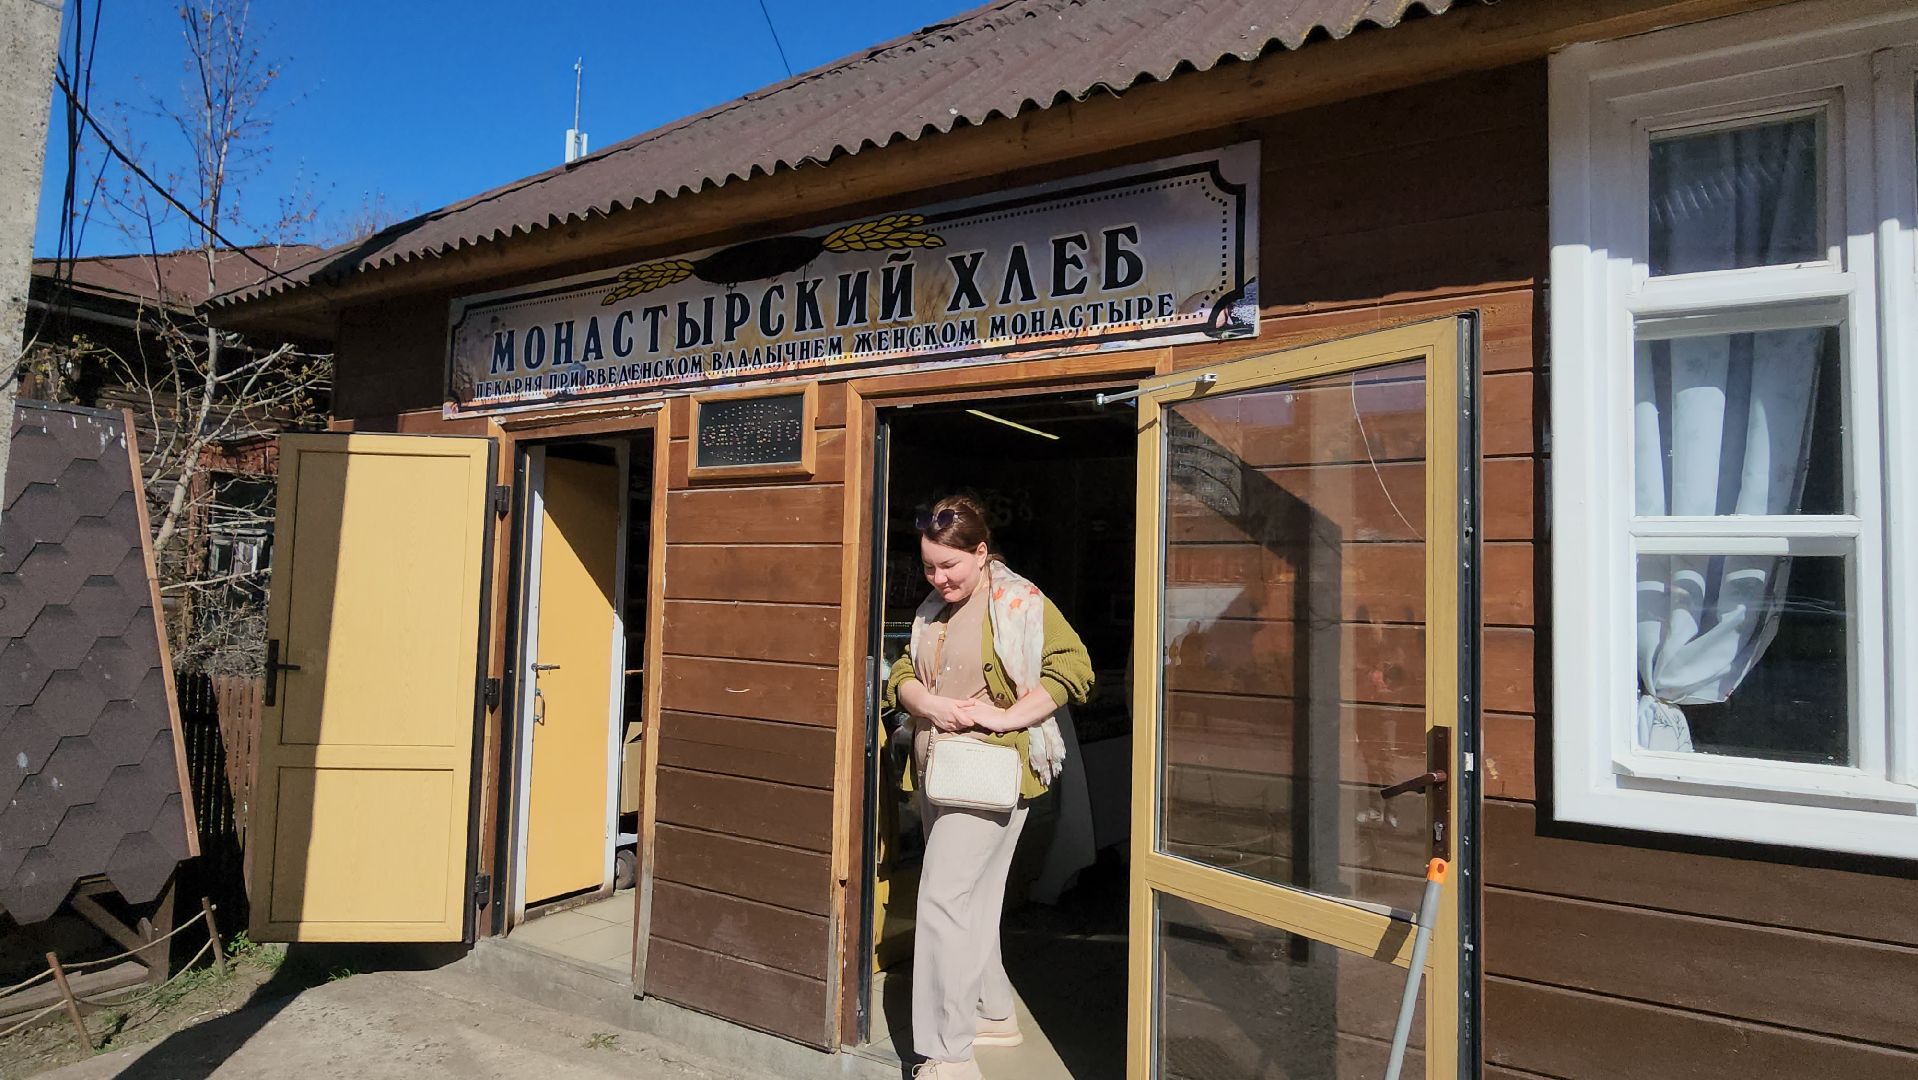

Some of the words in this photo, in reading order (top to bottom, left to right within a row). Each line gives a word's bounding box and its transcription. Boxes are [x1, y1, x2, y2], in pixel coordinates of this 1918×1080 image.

[475, 374, 543, 398] ПЕКАРНЯ
[549, 370, 580, 390] ПРИ
[586, 354, 703, 386] ВВЕДЕНСКОМ
[712, 336, 843, 371] ВЛАДЫЧНЕМ
[854, 319, 977, 353] ЖЕНСКОМ
[990, 293, 1174, 336] МОНАСТЫРЕ
[490, 250, 915, 375] МОНАСТЫРСКИЙ
[945, 225, 1144, 312] ХЛЕБ
